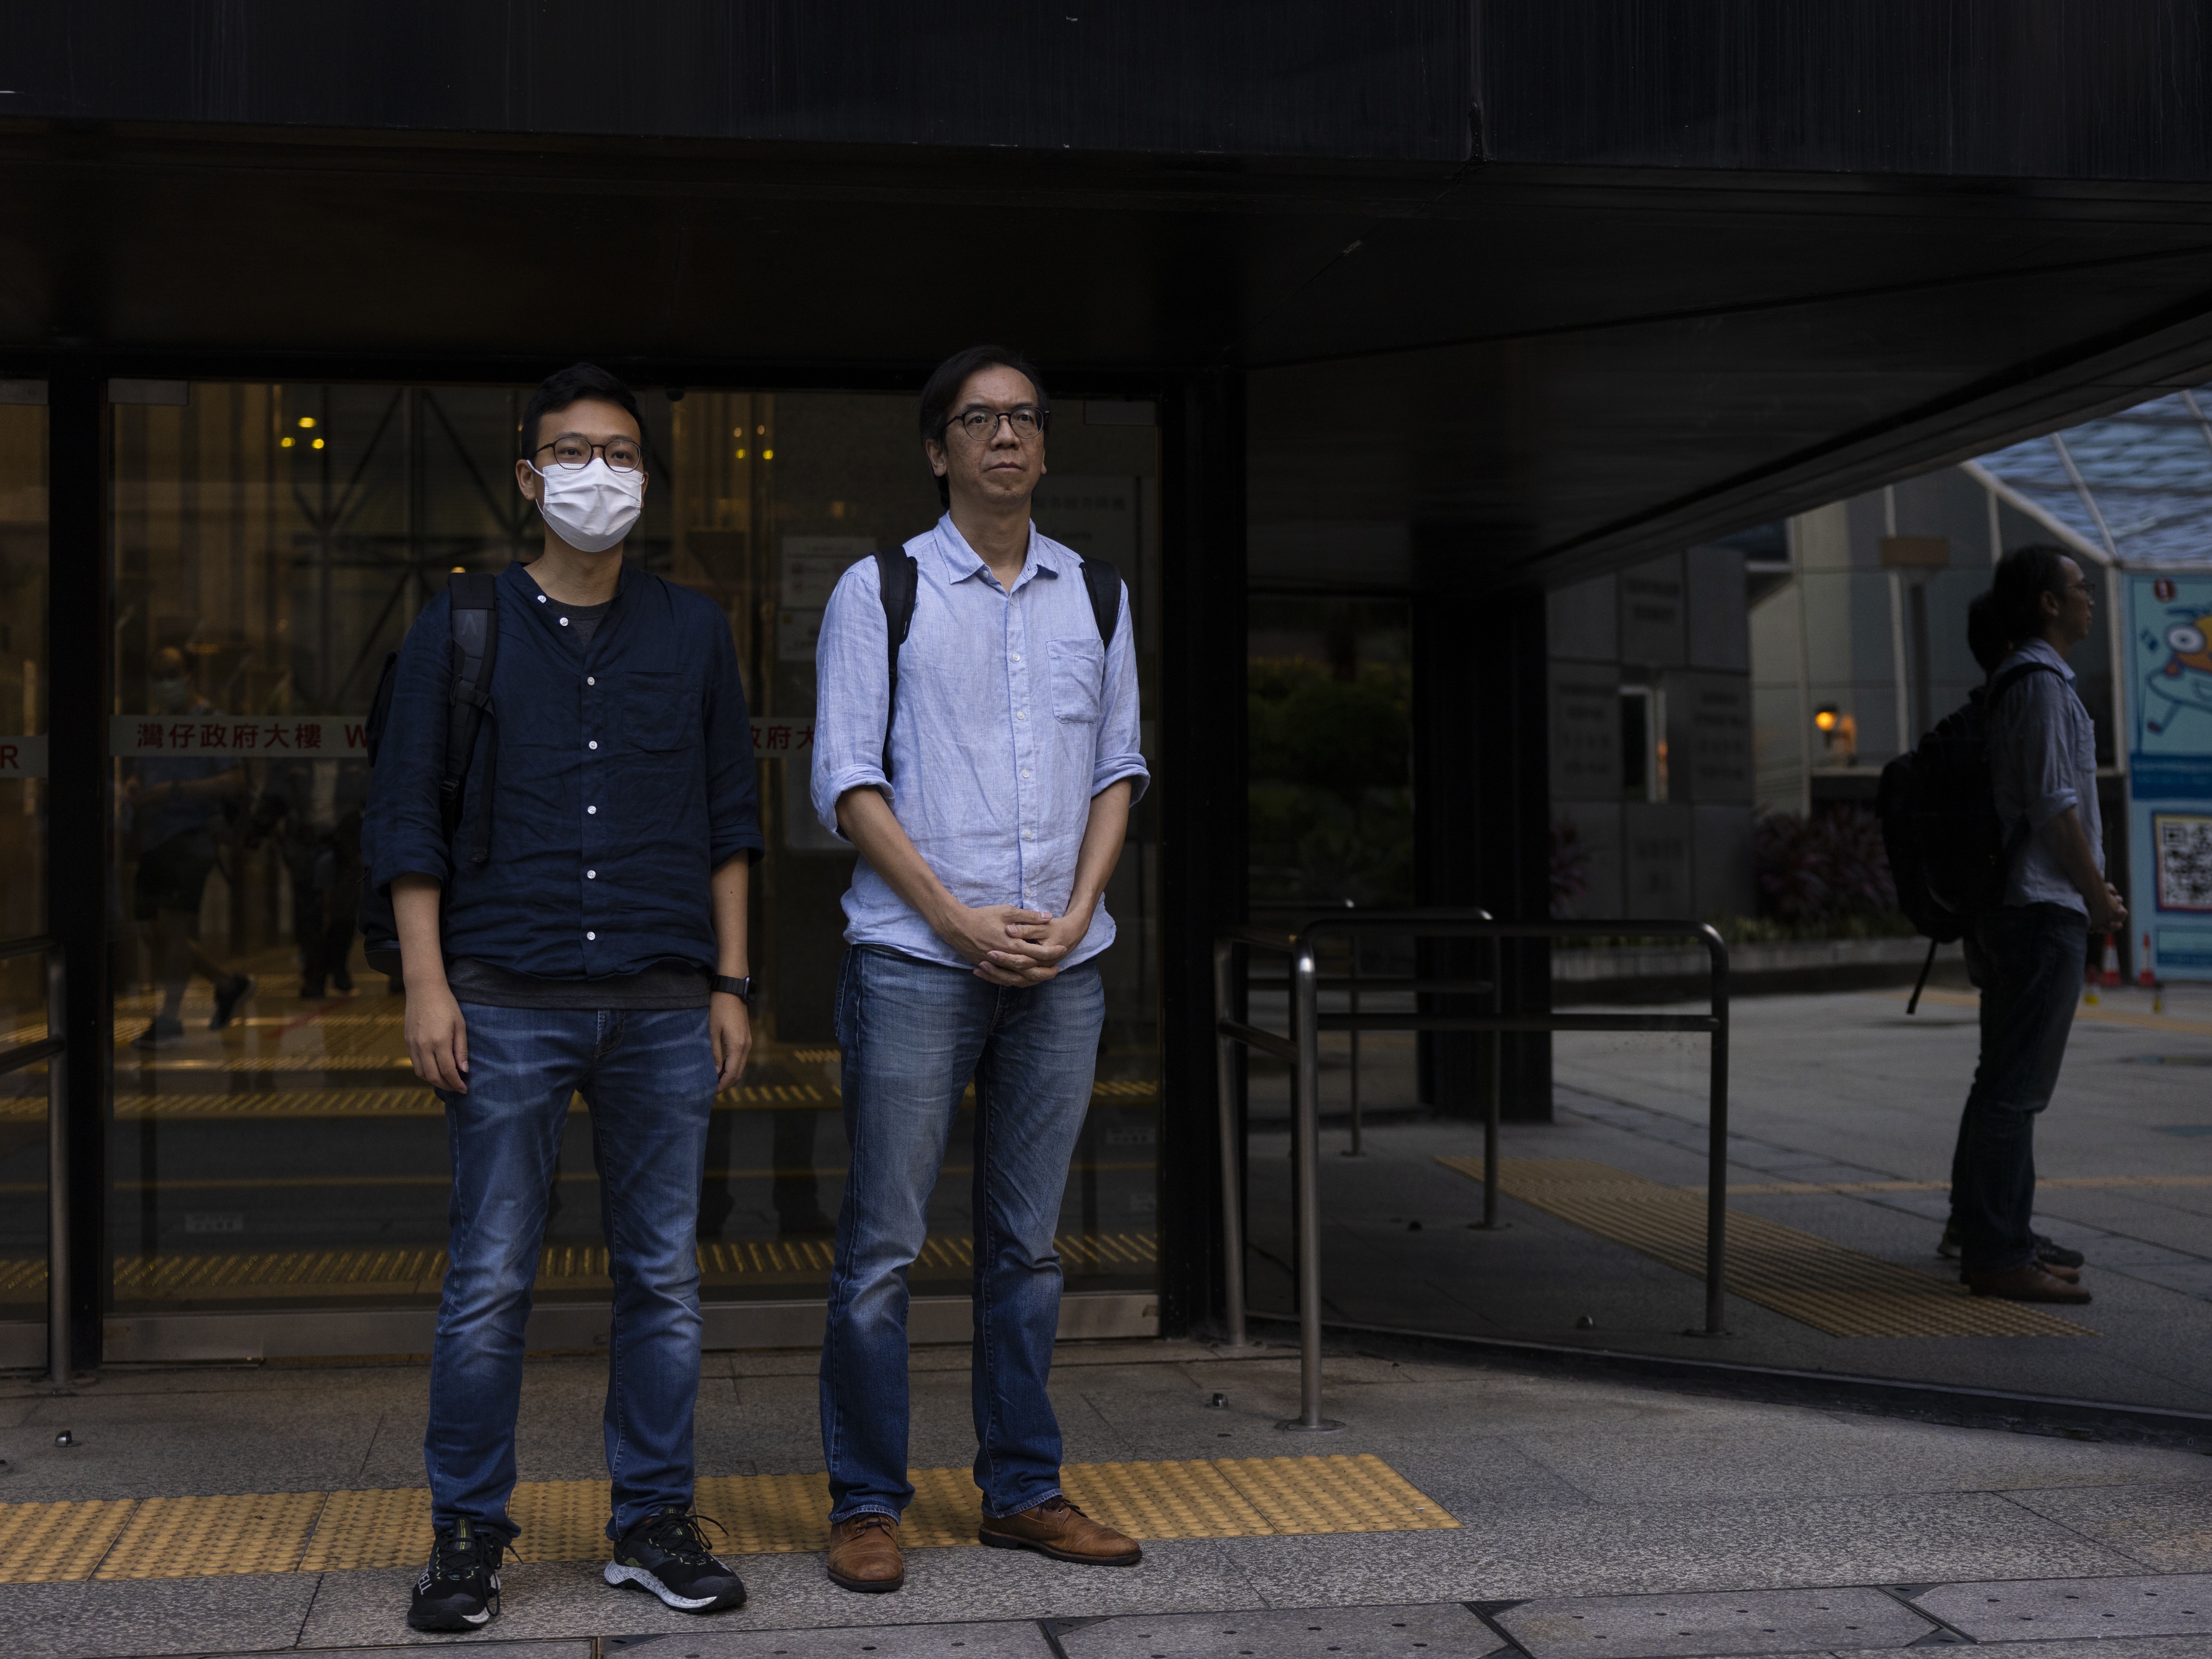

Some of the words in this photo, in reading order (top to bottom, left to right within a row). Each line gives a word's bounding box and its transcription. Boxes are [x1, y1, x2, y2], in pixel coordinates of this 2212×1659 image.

[137, 723, 322, 748] 灣仔政府大樓
[1, 745, 19, 769] R
[418, 1571, 432, 1596] ELL
